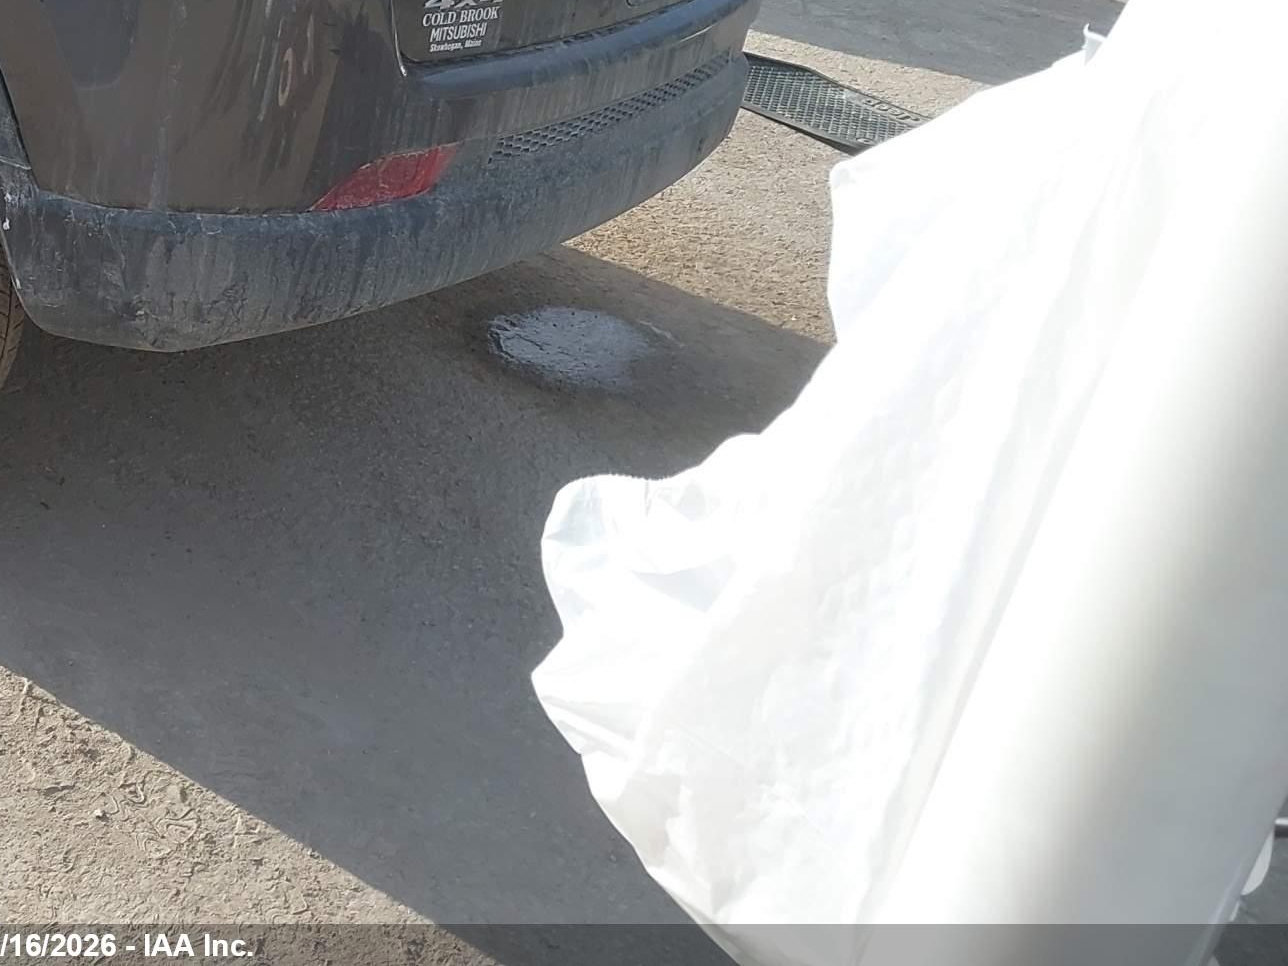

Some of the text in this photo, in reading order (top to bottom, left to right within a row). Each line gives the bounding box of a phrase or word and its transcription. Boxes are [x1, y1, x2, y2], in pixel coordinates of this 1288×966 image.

[423, 6, 500, 27] COLD BROOK
[430, 22, 488, 43] MITSUBISHI
